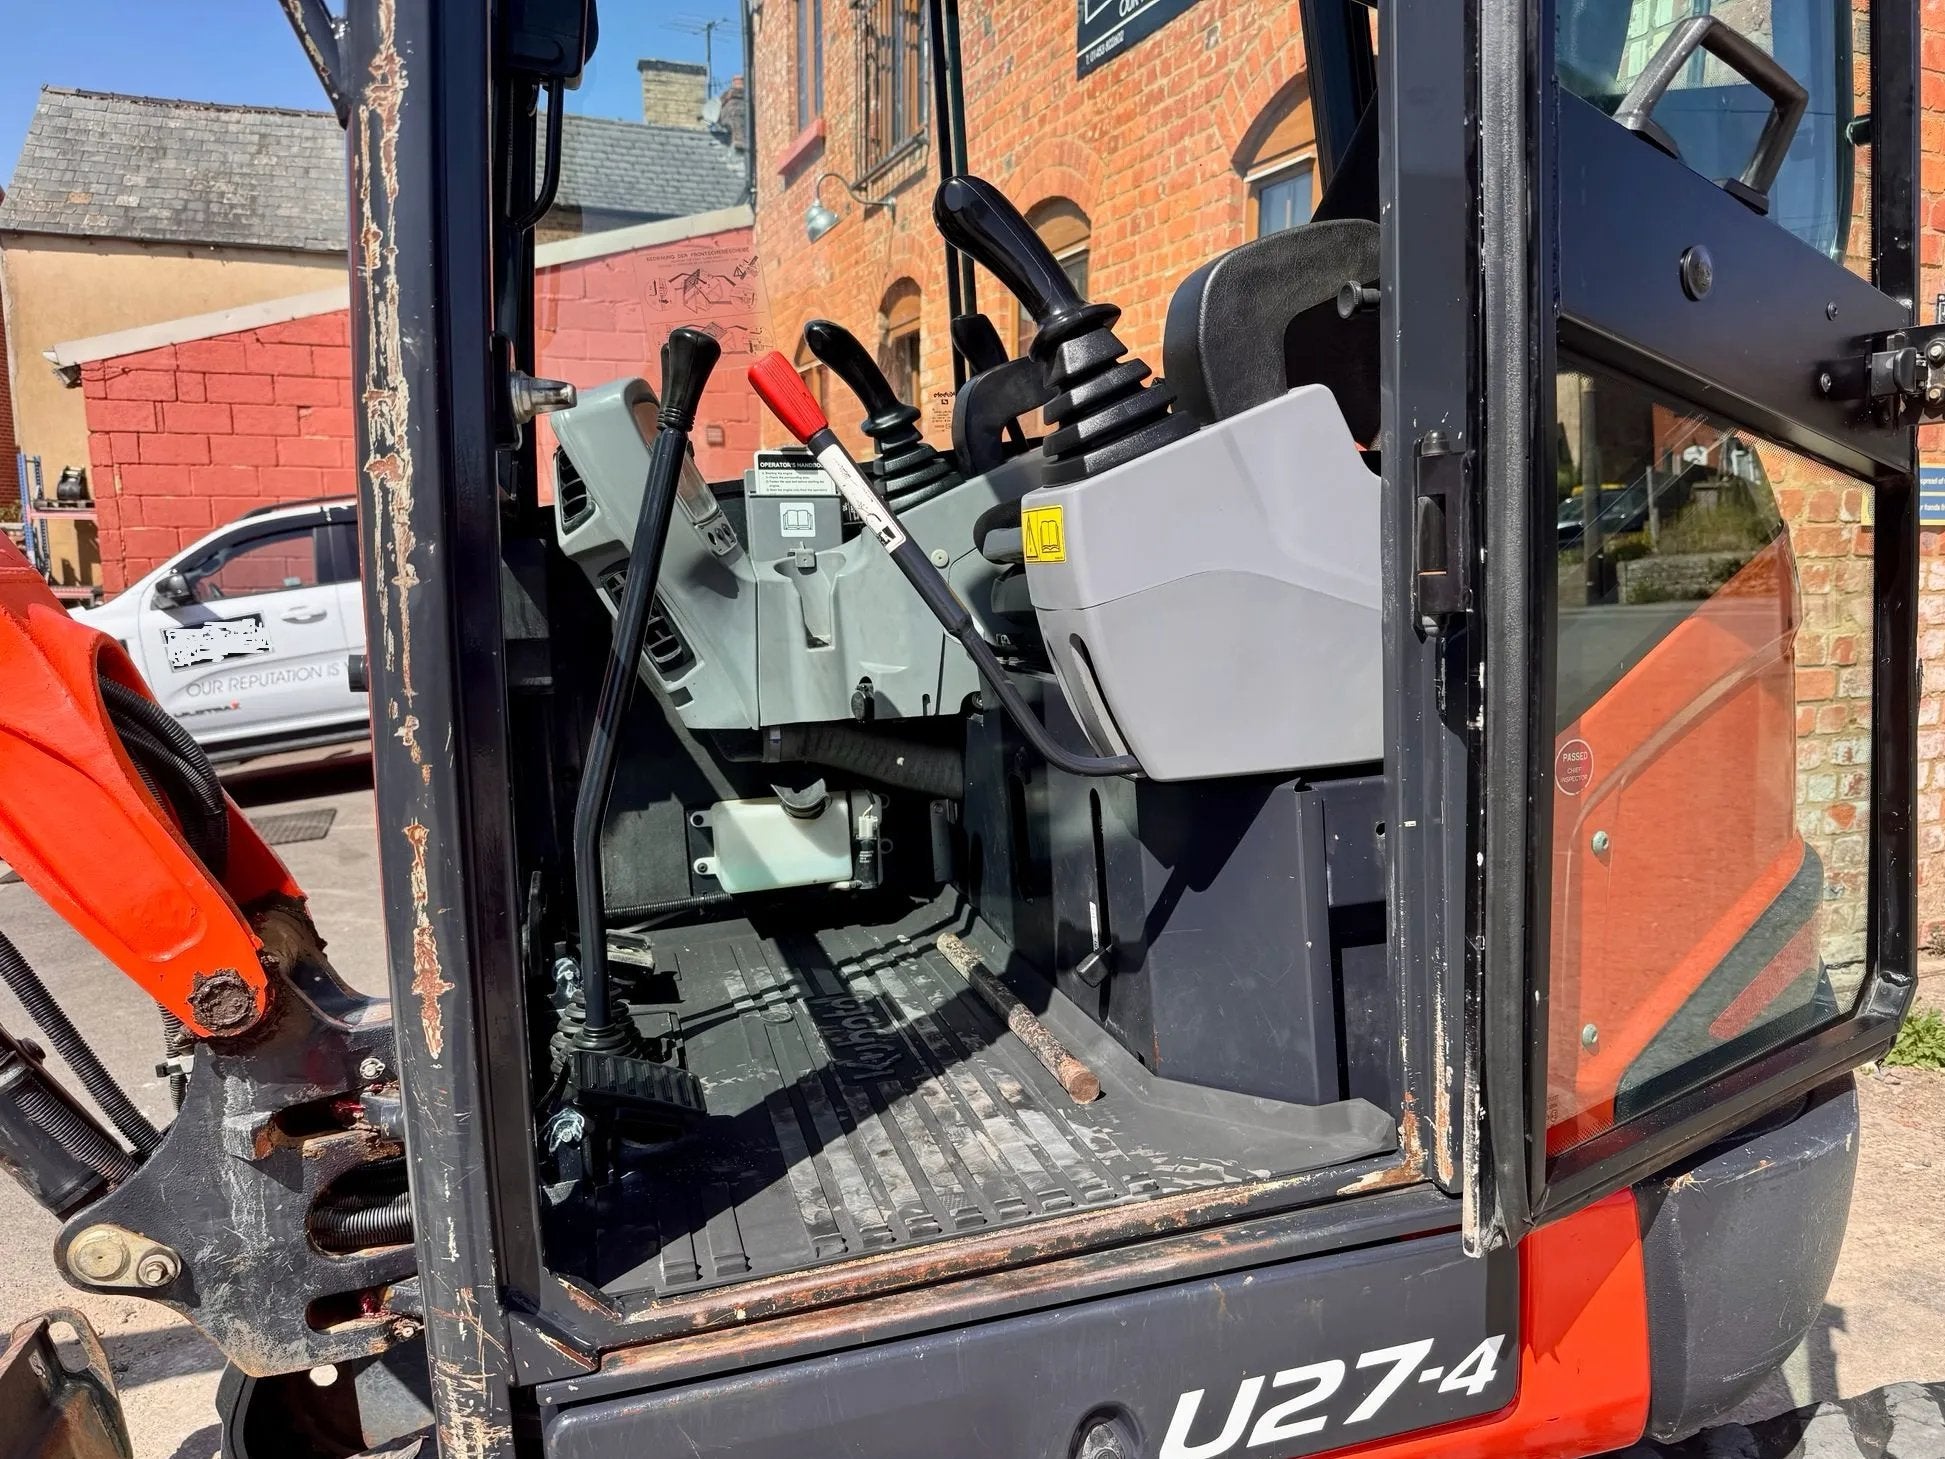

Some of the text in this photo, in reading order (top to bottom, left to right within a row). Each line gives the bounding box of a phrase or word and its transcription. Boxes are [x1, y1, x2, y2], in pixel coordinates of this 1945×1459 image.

[186, 680, 223, 697] OUR
[229, 664, 322, 692] REPUTATION
[327, 663, 340, 677] IS
[1562, 751, 1588, 762] PASSED
[1159, 1333, 1505, 1459] U27-4
